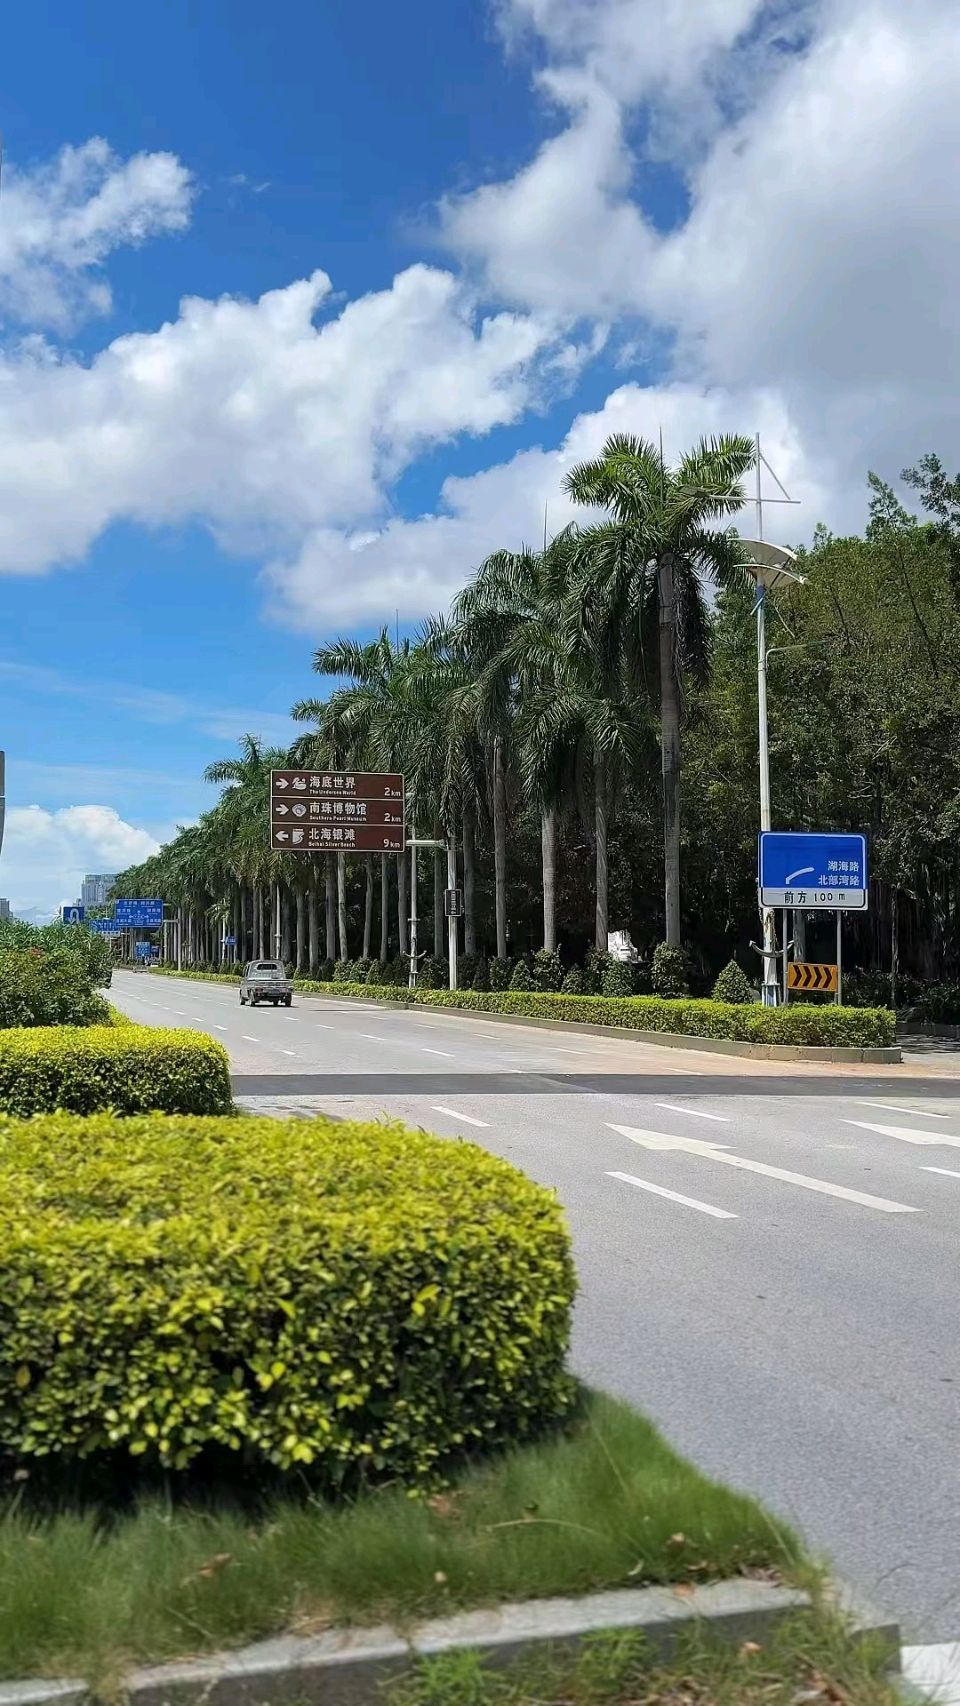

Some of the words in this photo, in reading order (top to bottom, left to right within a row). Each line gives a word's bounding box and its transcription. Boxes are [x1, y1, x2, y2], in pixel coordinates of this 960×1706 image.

[309, 775, 356, 789] 海底世界
[309, 801, 367, 815] 南珠博物馆
[308, 827, 356, 841] 北海银滩
[827, 860, 860, 872] 湖海路
[818, 874, 860, 886] 北部湾路
[814, 893, 833, 902] 100
[838, 893, 846, 901] m
